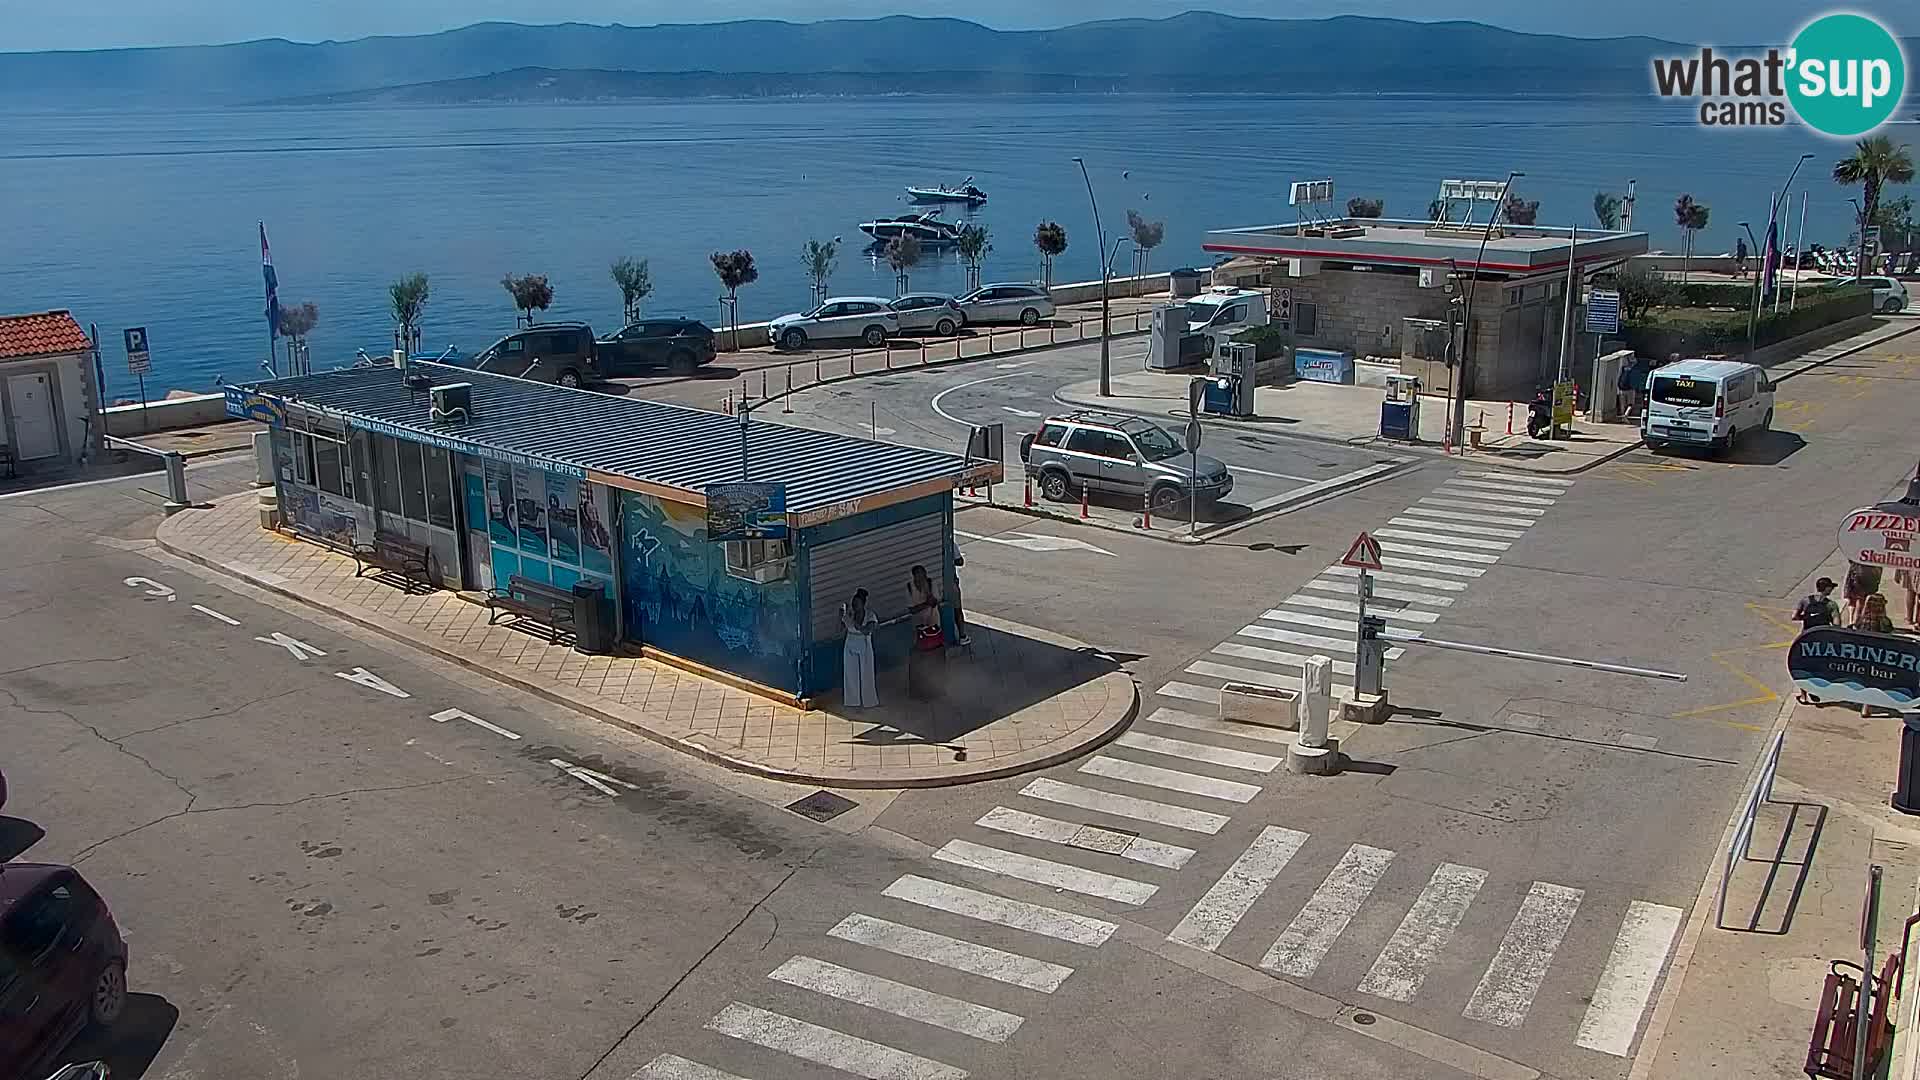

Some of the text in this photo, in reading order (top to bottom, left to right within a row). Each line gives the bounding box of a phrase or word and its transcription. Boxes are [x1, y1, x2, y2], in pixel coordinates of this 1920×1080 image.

[129, 331, 142, 349] P
[1675, 379, 1696, 388] TAXI
[395, 427, 436, 445] AUTOBUSNA
[436, 437, 468, 452] POSTAJA
[478, 447, 583, 477] BUS STATION TICKET OFFICE
[1828, 662, 1897, 680] caffe bar
